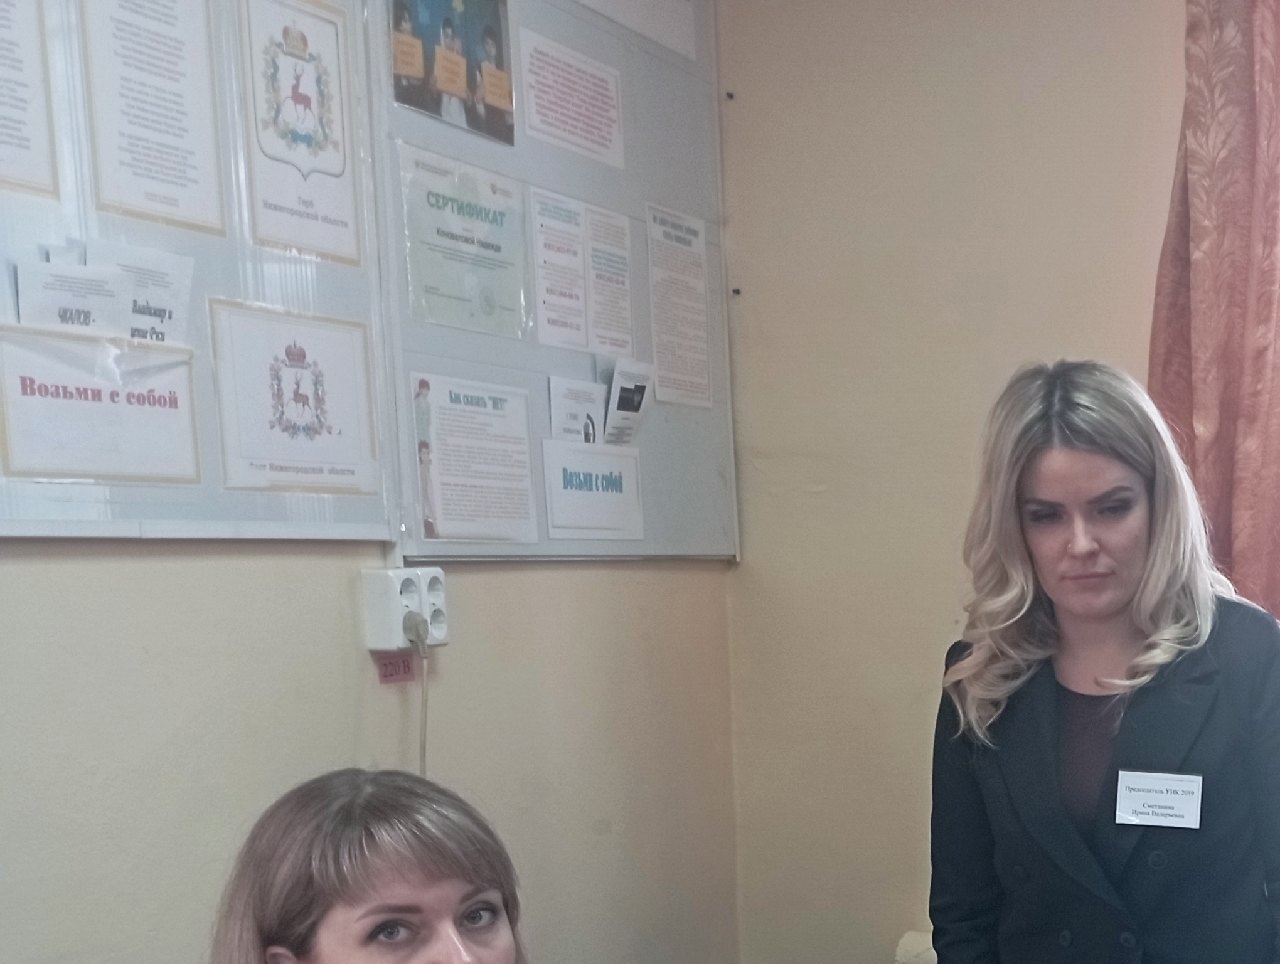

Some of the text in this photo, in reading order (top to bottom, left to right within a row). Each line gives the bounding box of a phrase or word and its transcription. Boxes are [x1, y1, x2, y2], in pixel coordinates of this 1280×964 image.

[427, 190, 506, 227] СЕРТИФИКАТ
[19, 376, 179, 409] Возьми с собой
[562, 467, 623, 494] Возьми с собой
[383, 661, 400, 678] 220
